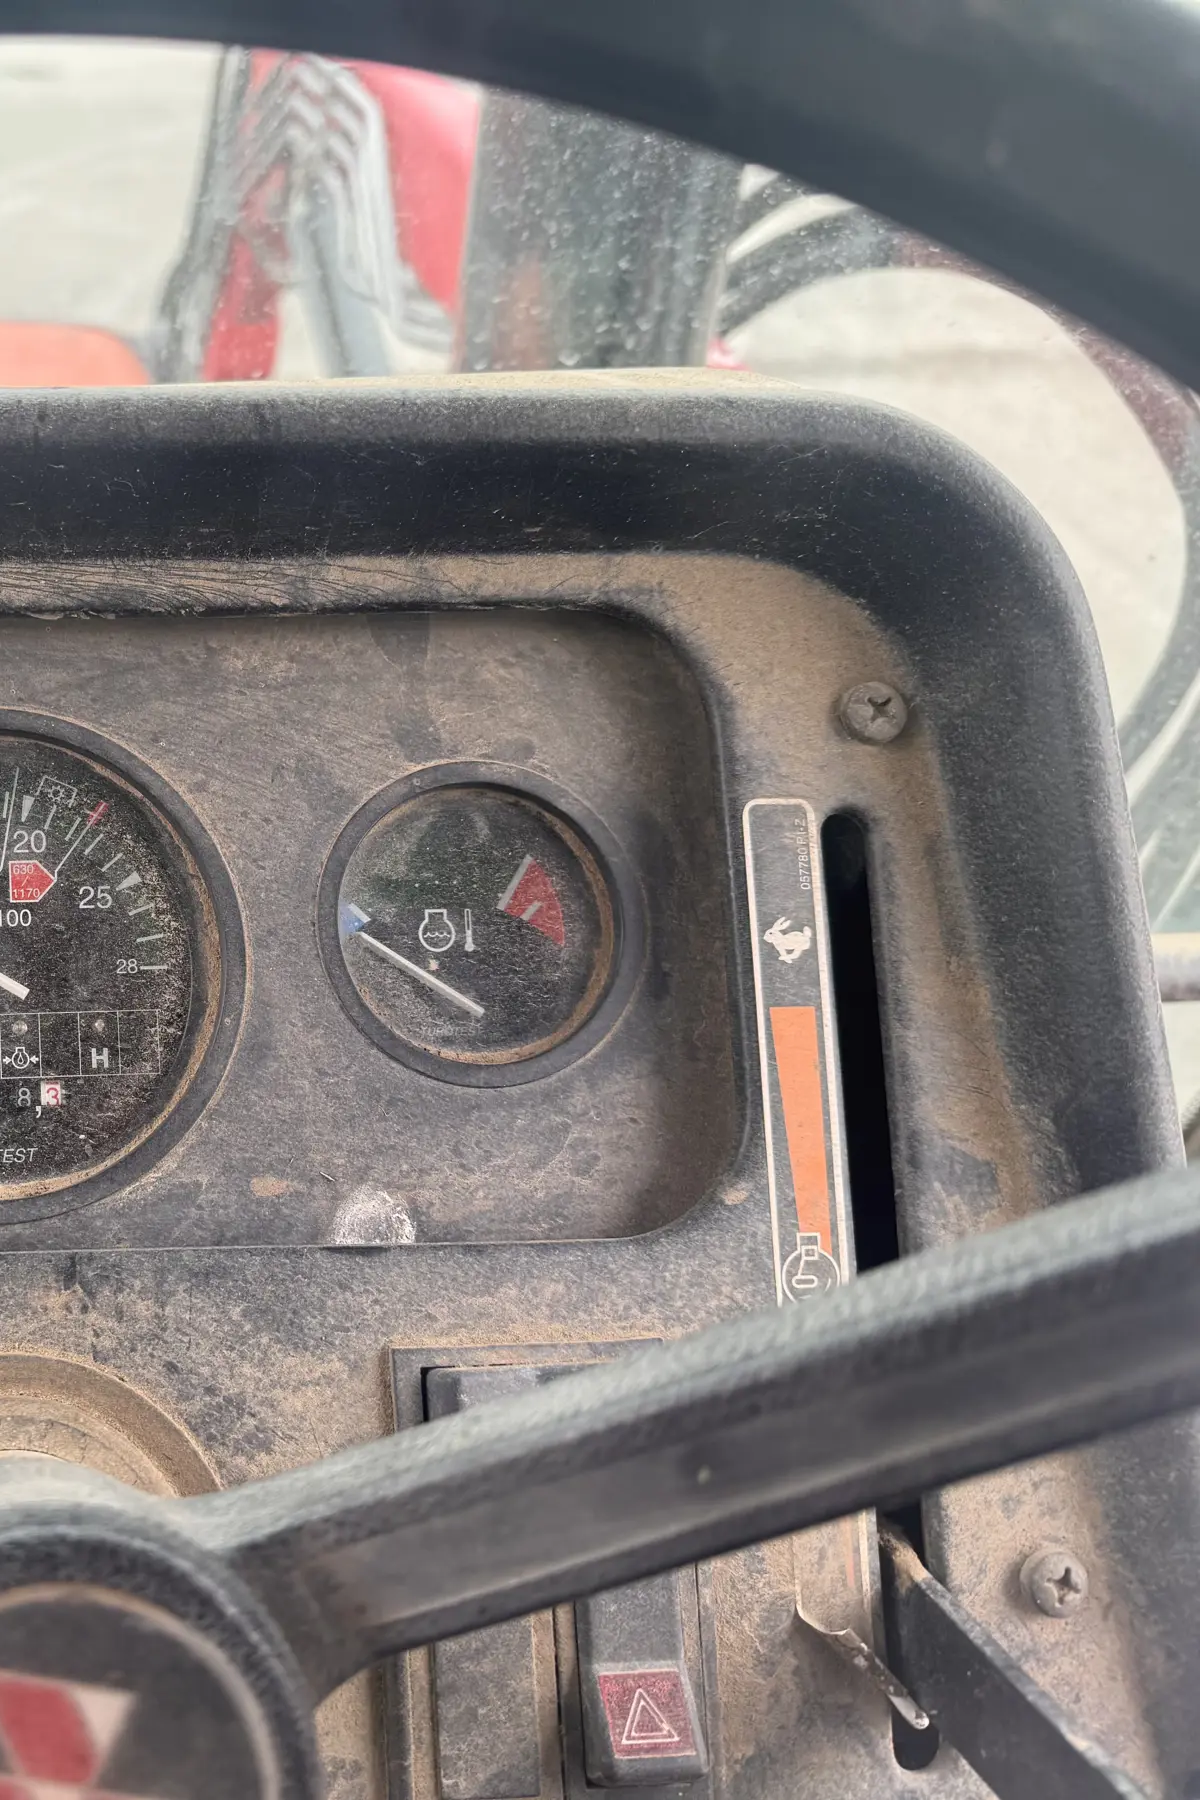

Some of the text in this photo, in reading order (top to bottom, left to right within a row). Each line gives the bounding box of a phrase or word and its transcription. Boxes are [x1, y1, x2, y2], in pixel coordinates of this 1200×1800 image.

[13, 830, 47, 853] 20
[12, 865, 34, 875] 630
[13, 888, 41, 898] 1170
[79, 886, 112, 909] 25
[116, 959, 138, 973] 28
[91, 1047, 109, 1069] H
